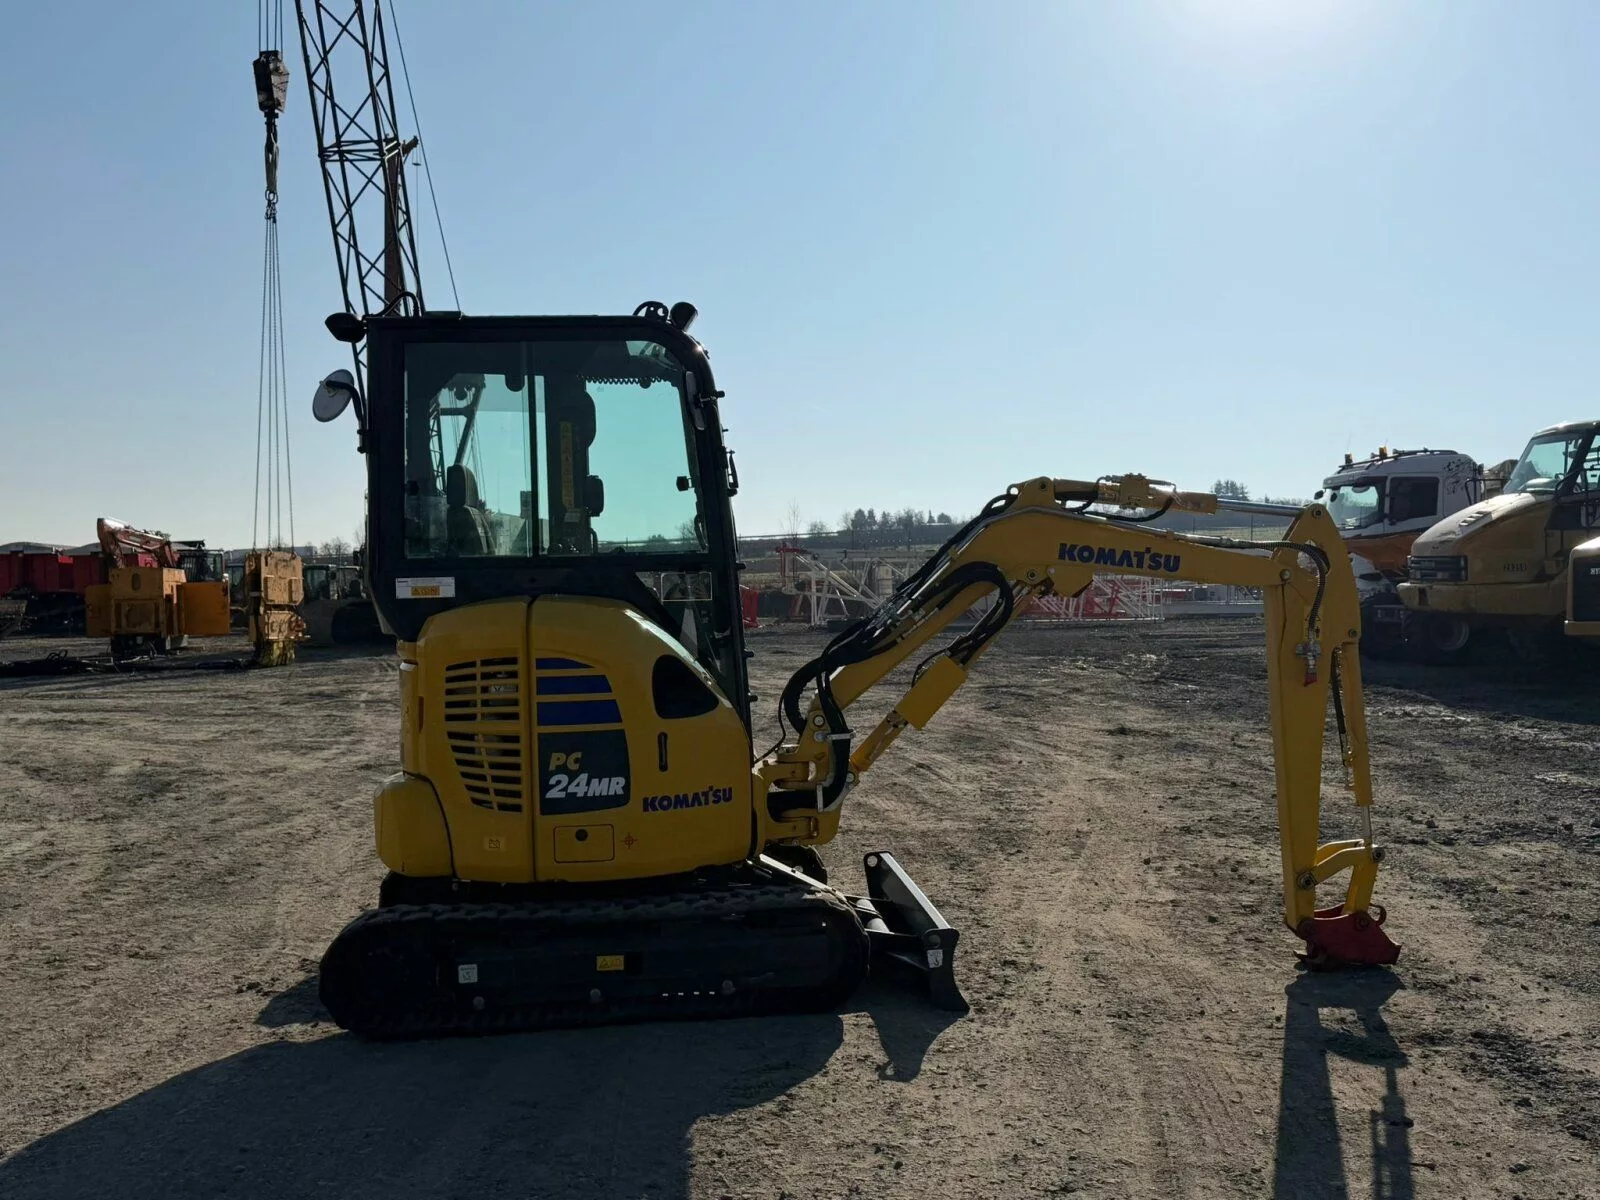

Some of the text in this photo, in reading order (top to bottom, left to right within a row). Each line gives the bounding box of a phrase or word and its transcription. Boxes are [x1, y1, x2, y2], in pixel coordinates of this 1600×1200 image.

[1058, 543, 1180, 572] KOMATSU
[549, 752, 582, 771] PC
[545, 773, 625, 798] 24MR
[643, 785, 732, 812] KOMATSU
